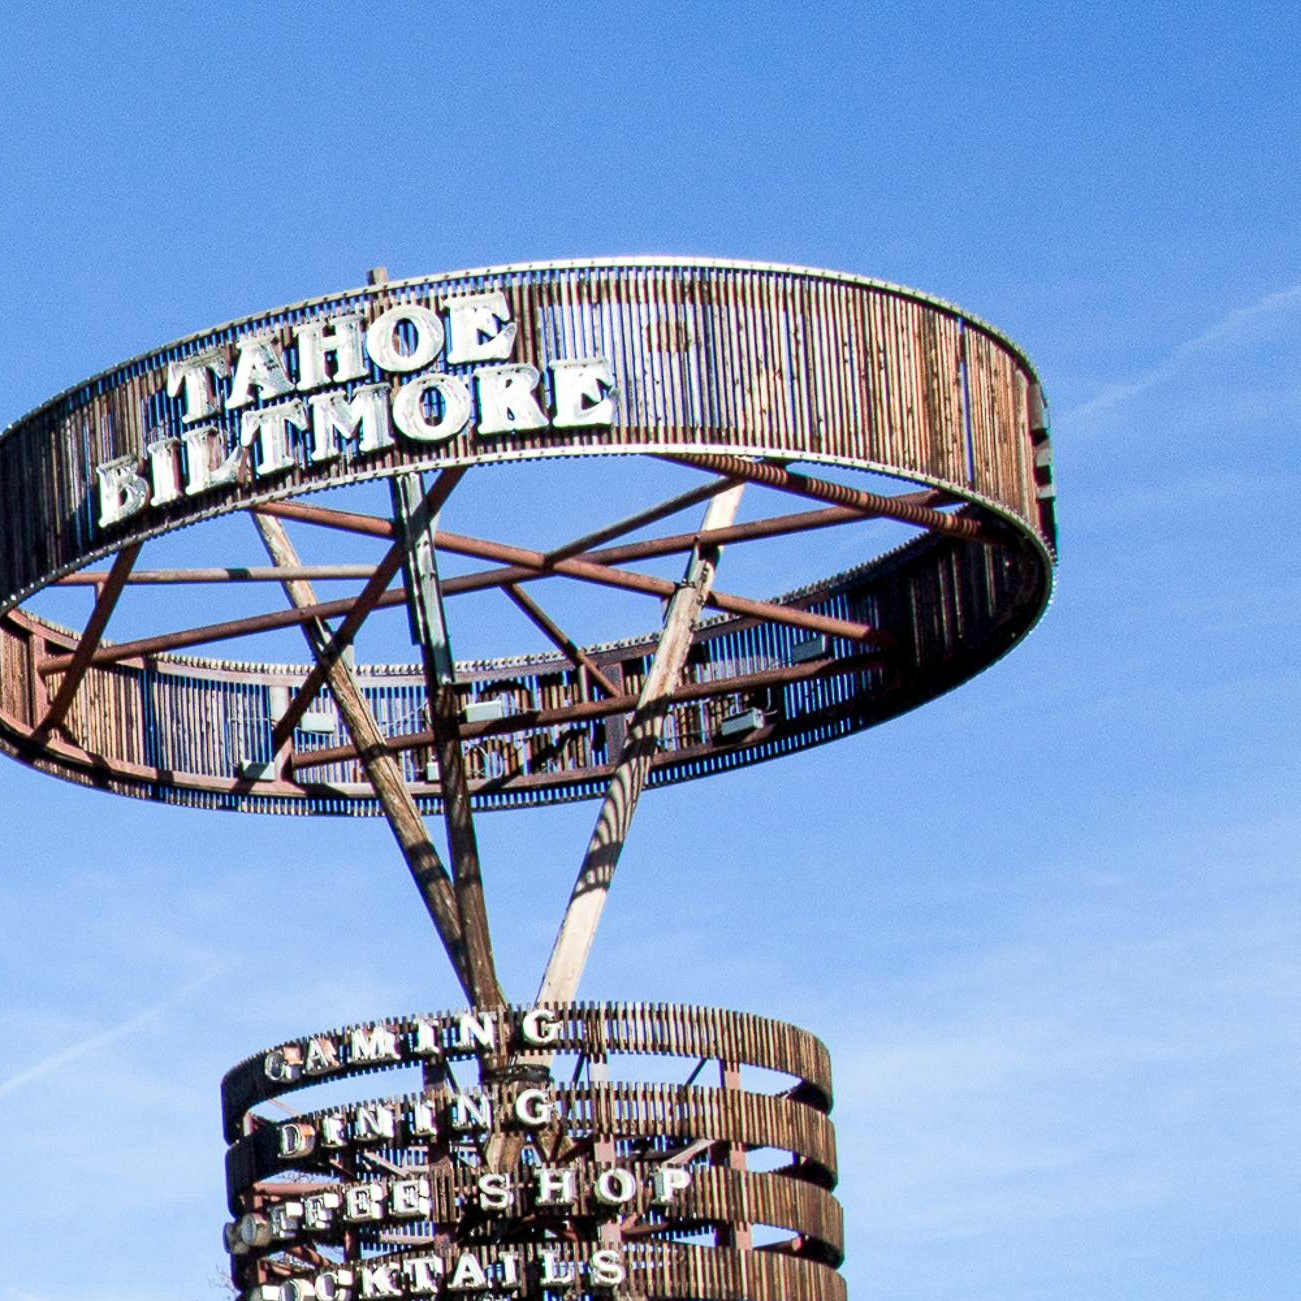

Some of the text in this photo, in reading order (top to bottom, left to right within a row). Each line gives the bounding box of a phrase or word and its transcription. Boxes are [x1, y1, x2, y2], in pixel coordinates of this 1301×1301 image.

[167, 291, 517, 424] TAHOE
[97, 358, 617, 528] BILTMORE
[264, 1008, 565, 1081] GAMING
[277, 1088, 554, 1160] DINING
[478, 1168, 692, 1210] SHOP
